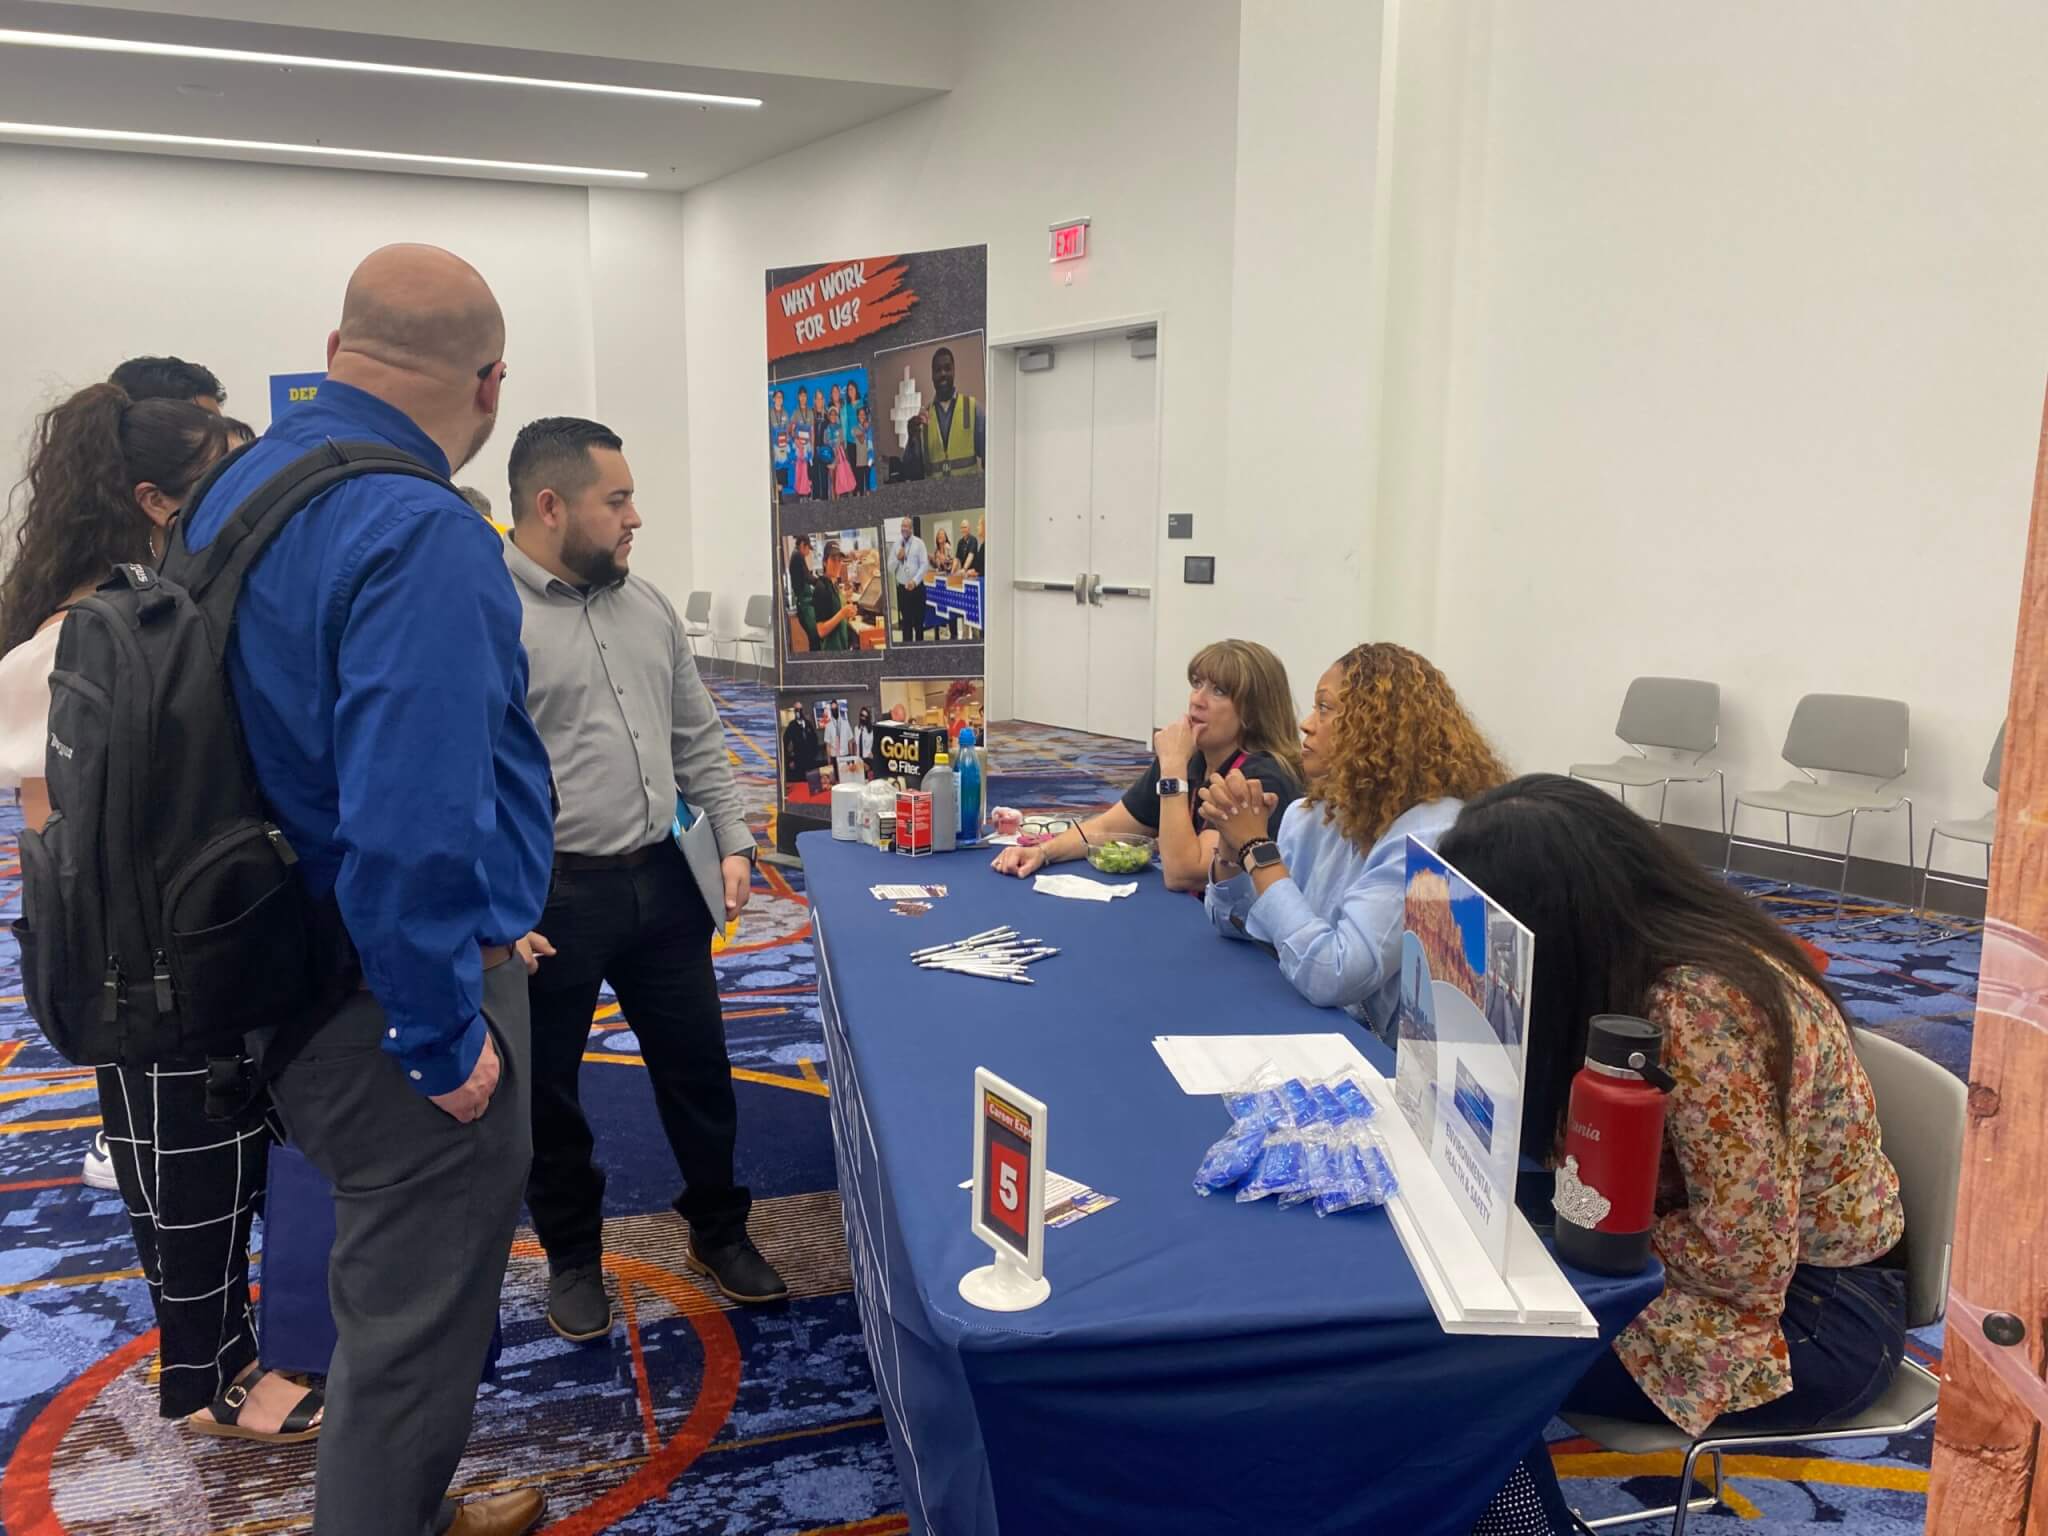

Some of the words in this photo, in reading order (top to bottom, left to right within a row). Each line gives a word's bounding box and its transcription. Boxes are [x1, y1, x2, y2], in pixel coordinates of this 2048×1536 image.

[1056, 226, 1079, 257] EXIT
[781, 282, 815, 317] WHY
[819, 261, 867, 302] WORK
[795, 313, 826, 344] FOR
[829, 297, 860, 331] US?
[880, 735, 919, 762] Gold
[999, 1161, 1018, 1210] 5
